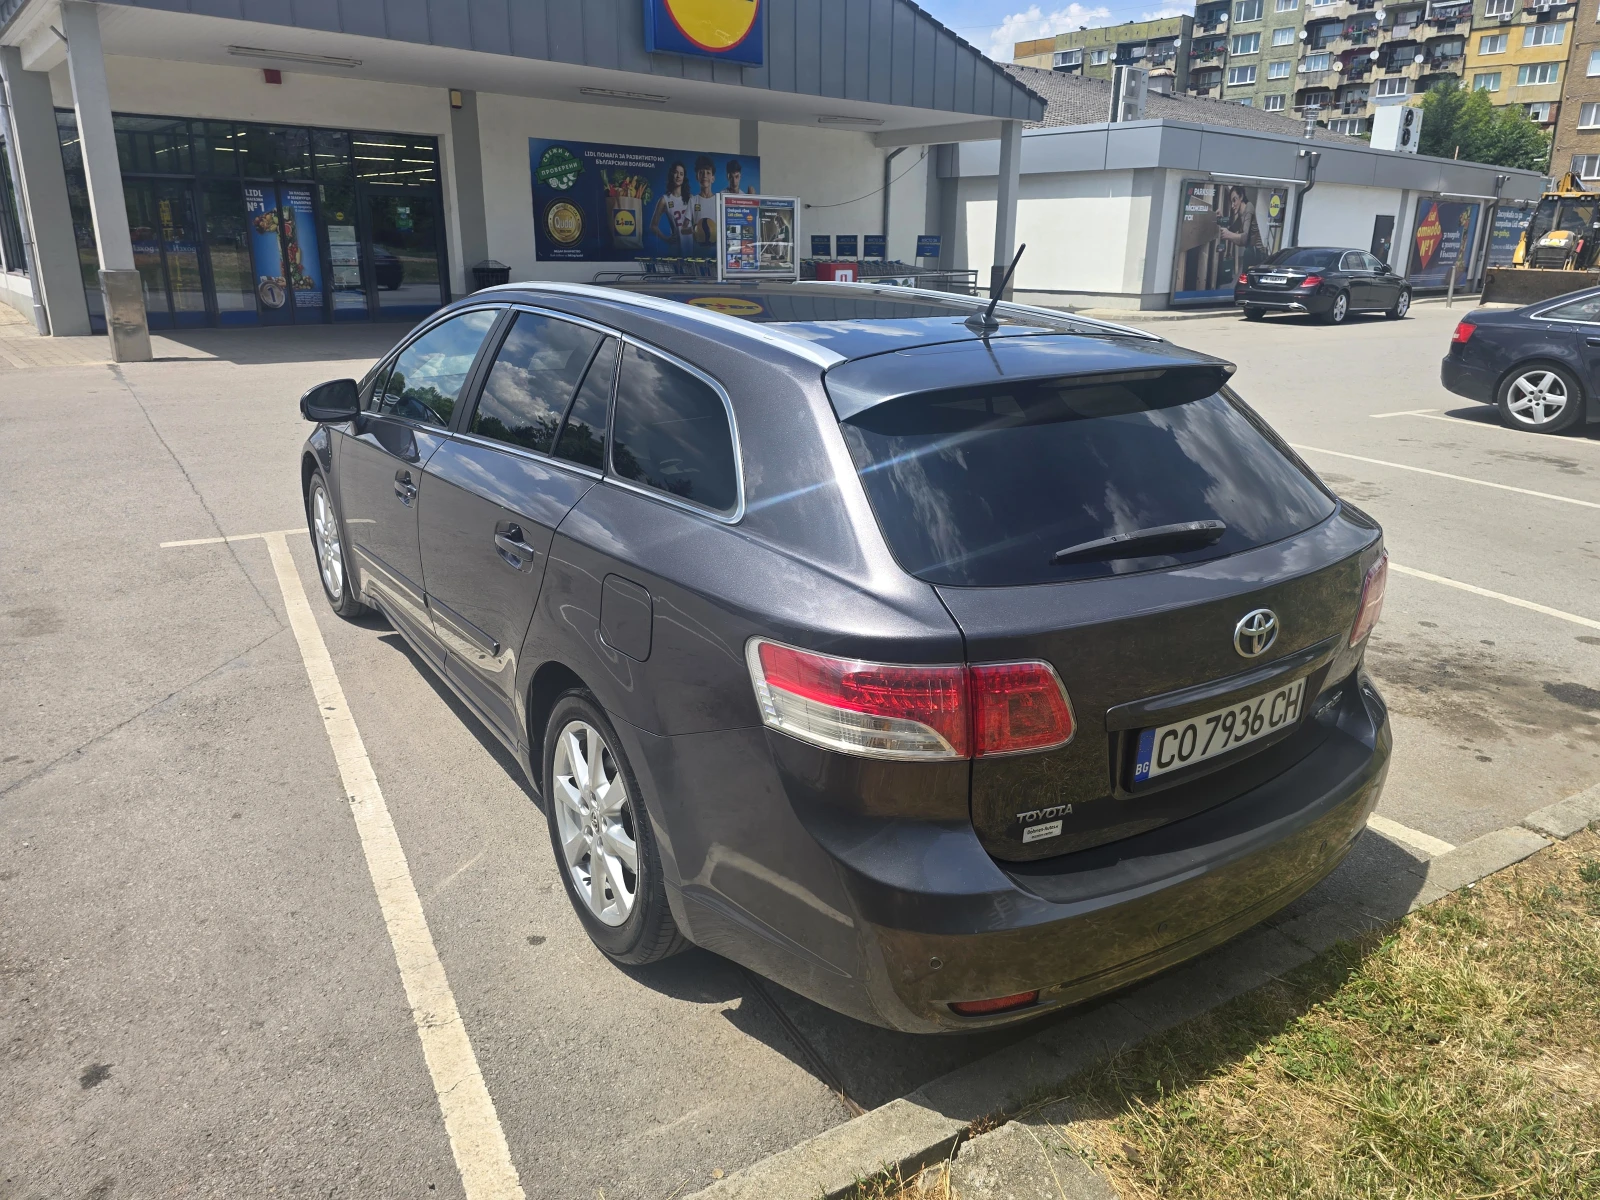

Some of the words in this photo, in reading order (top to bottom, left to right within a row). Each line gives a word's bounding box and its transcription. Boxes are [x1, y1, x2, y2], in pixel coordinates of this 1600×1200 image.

[544, 148, 563, 162] СВЕЖИ
[541, 162, 578, 175] ПРОВЕРЕНИ
[1194, 188, 1216, 196] PARKSIDE
[616, 217, 634, 227] LIDL
[1540, 238, 1569, 247] CAT
[1157, 723, 1198, 769] CO
[1201, 698, 1265, 756] 7936
[1268, 683, 1302, 729] CH
[1136, 762, 1149, 776] BG
[1017, 804, 1072, 823] TOYOTA
